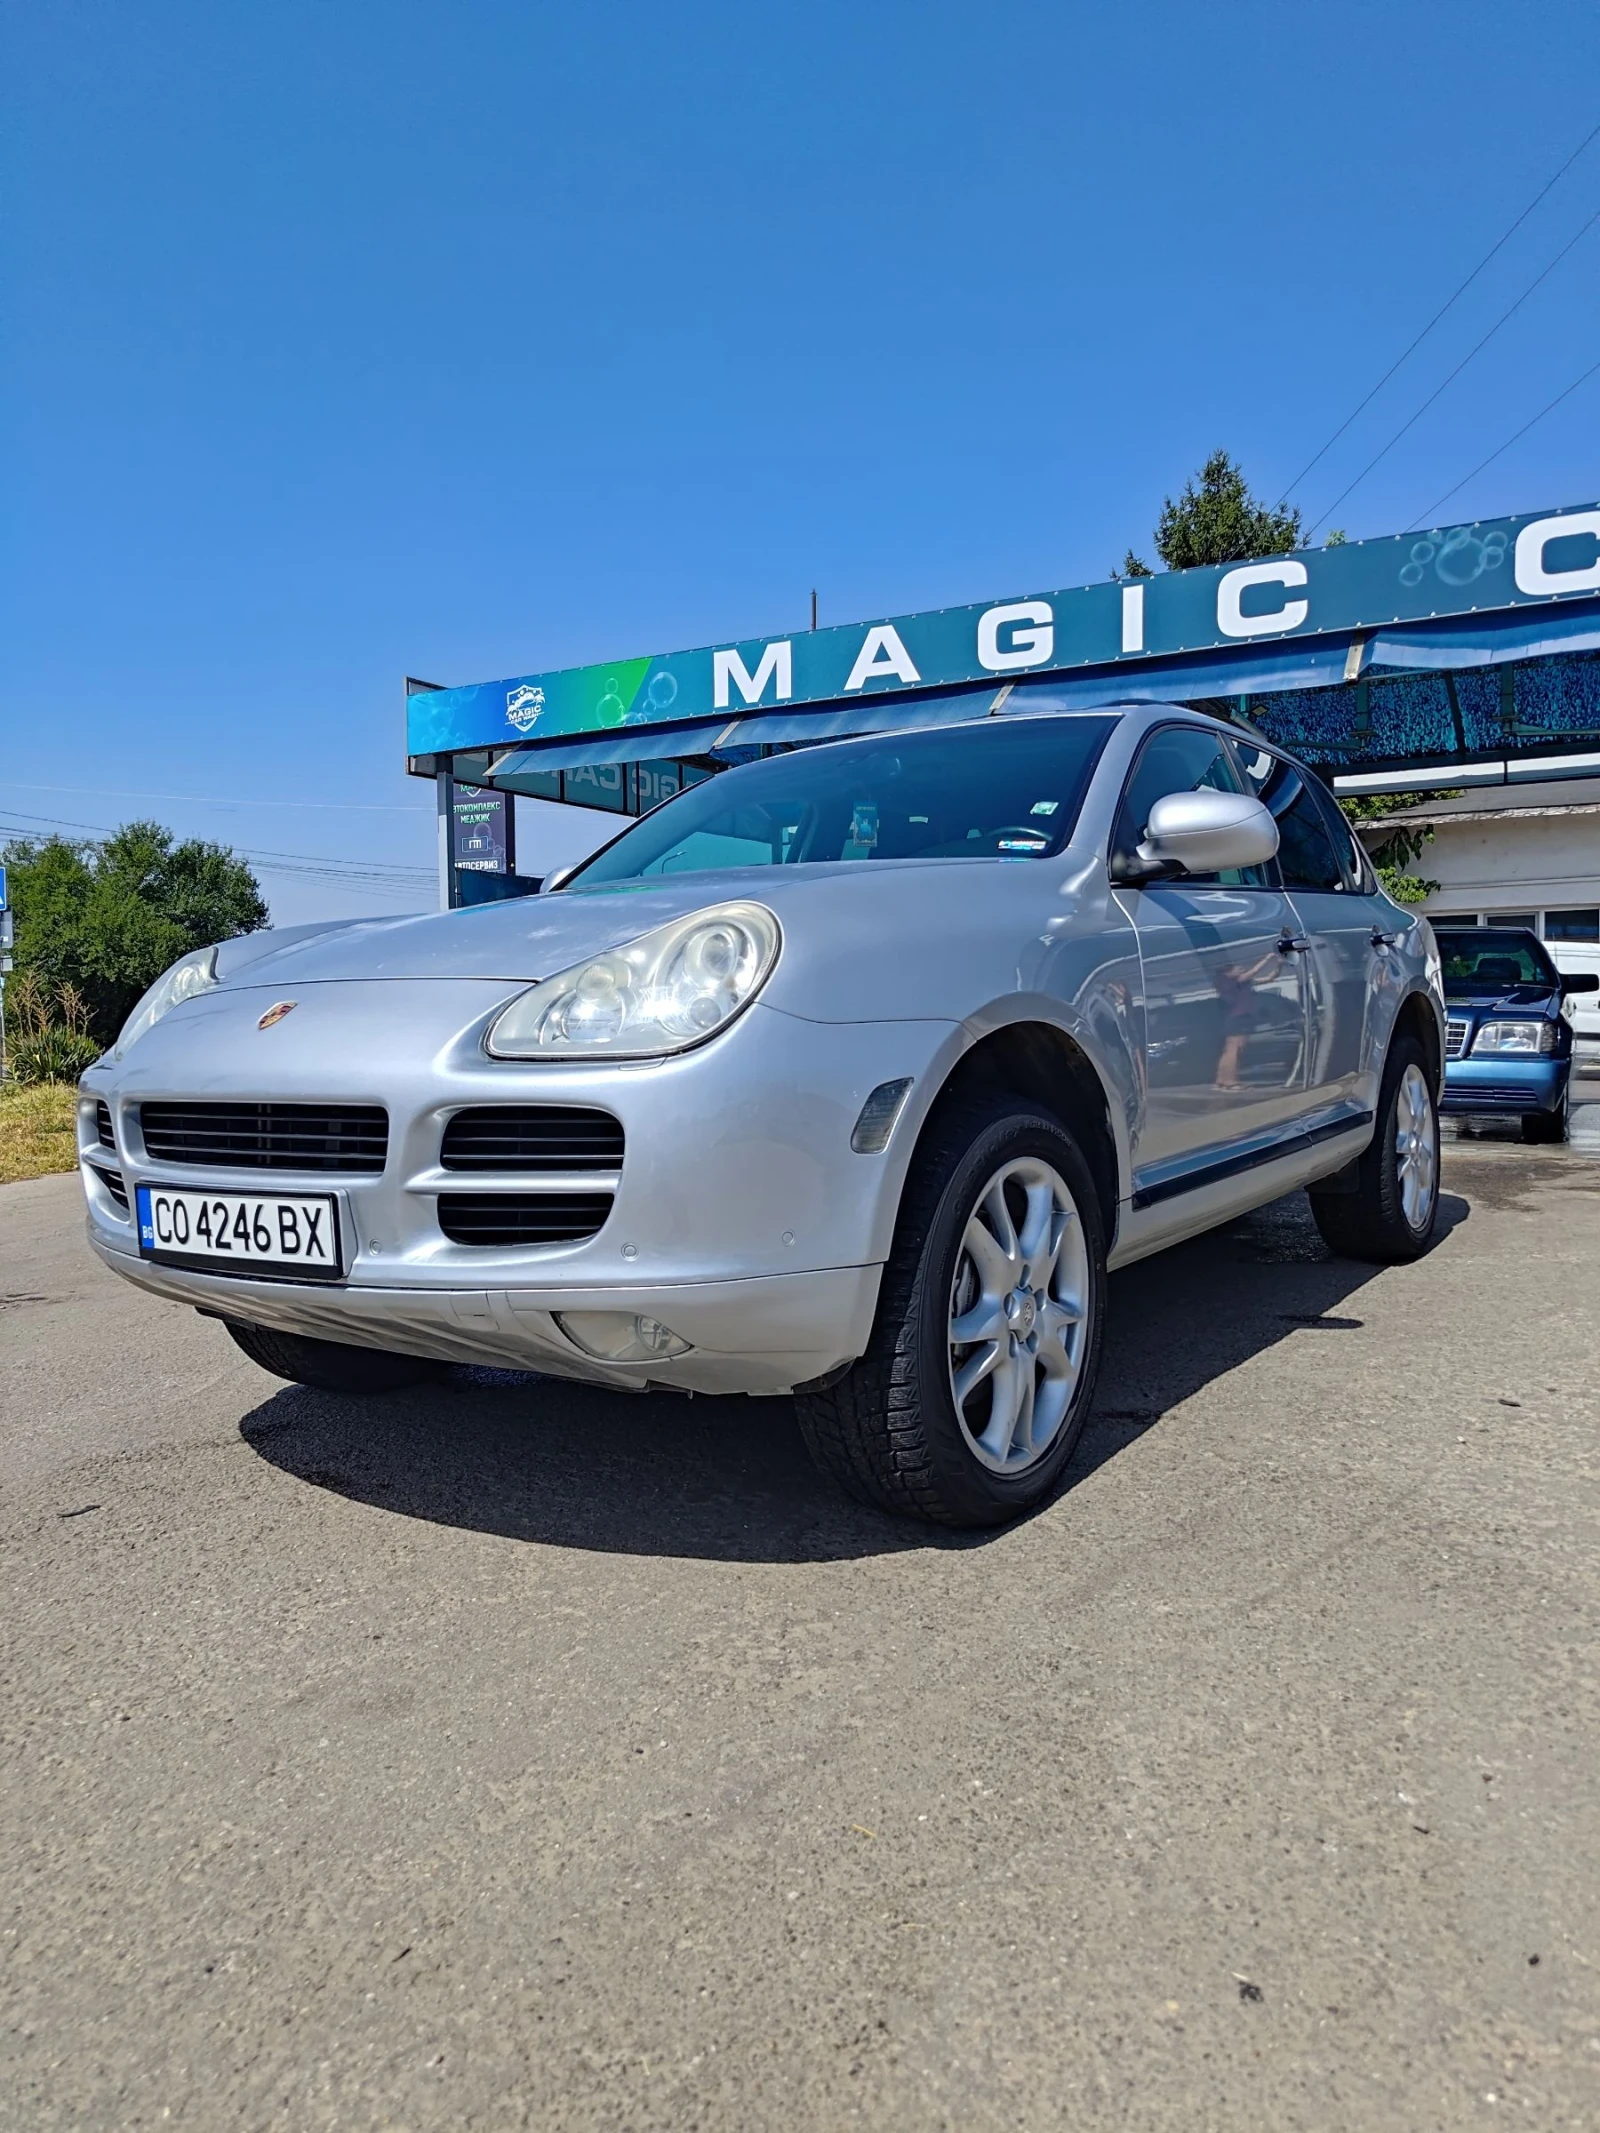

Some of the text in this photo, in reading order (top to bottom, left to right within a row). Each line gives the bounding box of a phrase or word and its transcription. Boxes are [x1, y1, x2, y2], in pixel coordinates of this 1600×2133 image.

[713, 560, 1308, 708] MAGIC
[508, 705, 541, 720] MAGIC
[453, 801, 501, 813] ВТОКОМПЛЕКС
[460, 812, 490, 823] МЕДЖИК
[142, 1225, 153, 1239] BG
[196, 1200, 271, 1253] 4246
